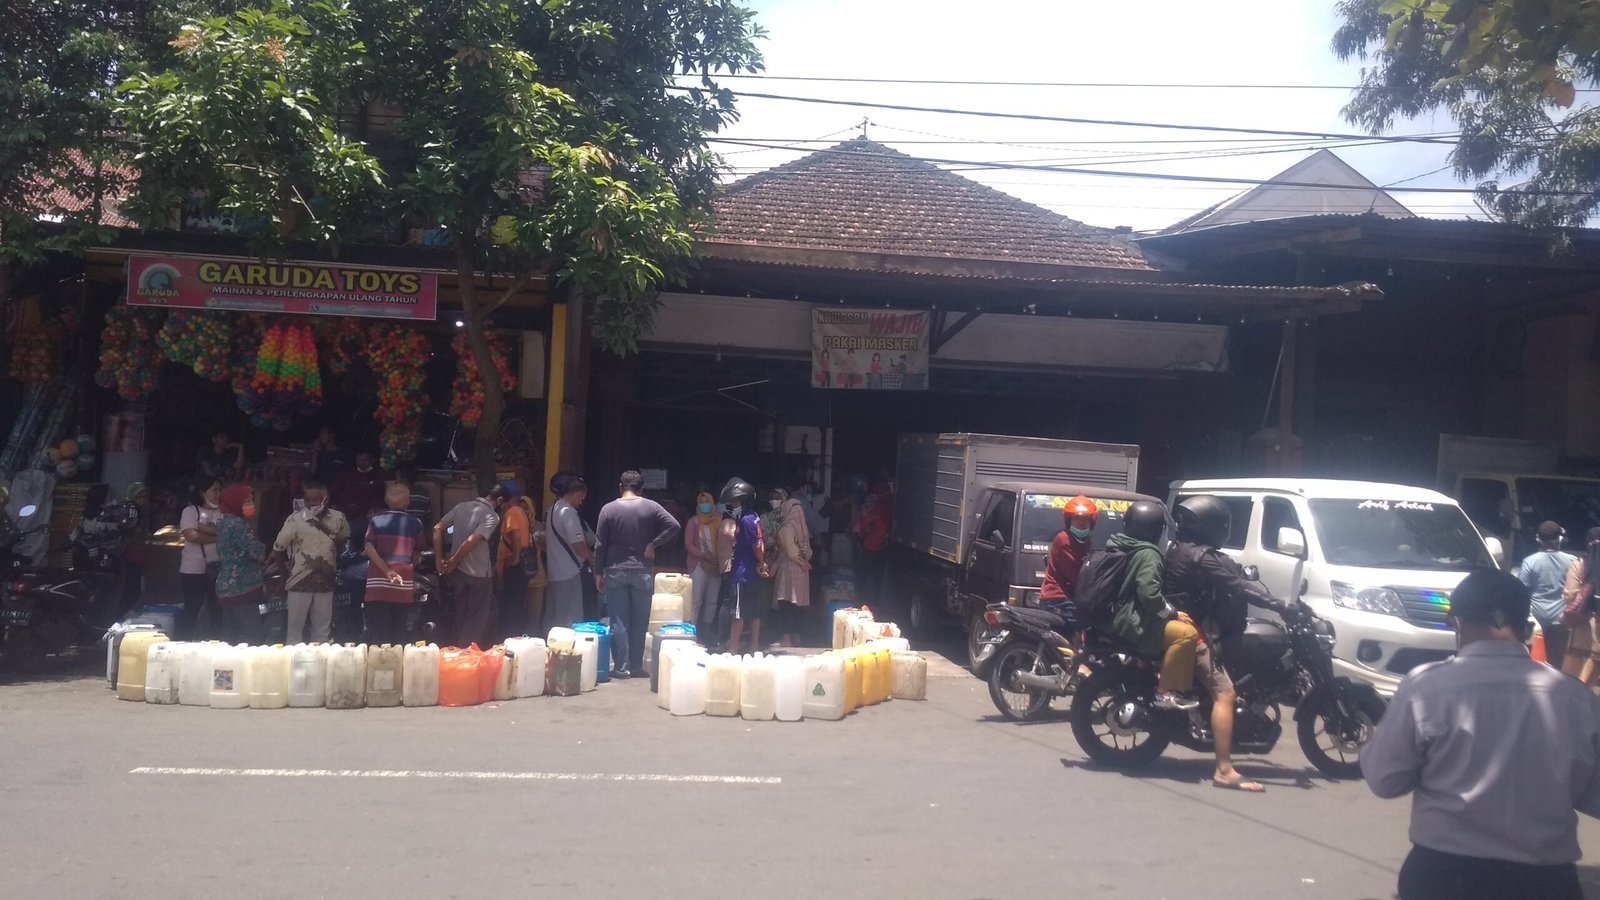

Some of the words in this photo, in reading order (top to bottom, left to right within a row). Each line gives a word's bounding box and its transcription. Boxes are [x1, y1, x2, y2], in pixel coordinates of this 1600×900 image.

[199, 261, 335, 290] GARUDA
[342, 270, 419, 294] TOYS
[213, 287, 253, 295] MAINAN
[267, 289, 346, 300] PERLENGKAPAN
[350, 294, 382, 302] ULANG
[385, 296, 417, 304] TAHUN
[823, 335, 862, 350] PAKAI
[865, 336, 918, 352] MASKER
